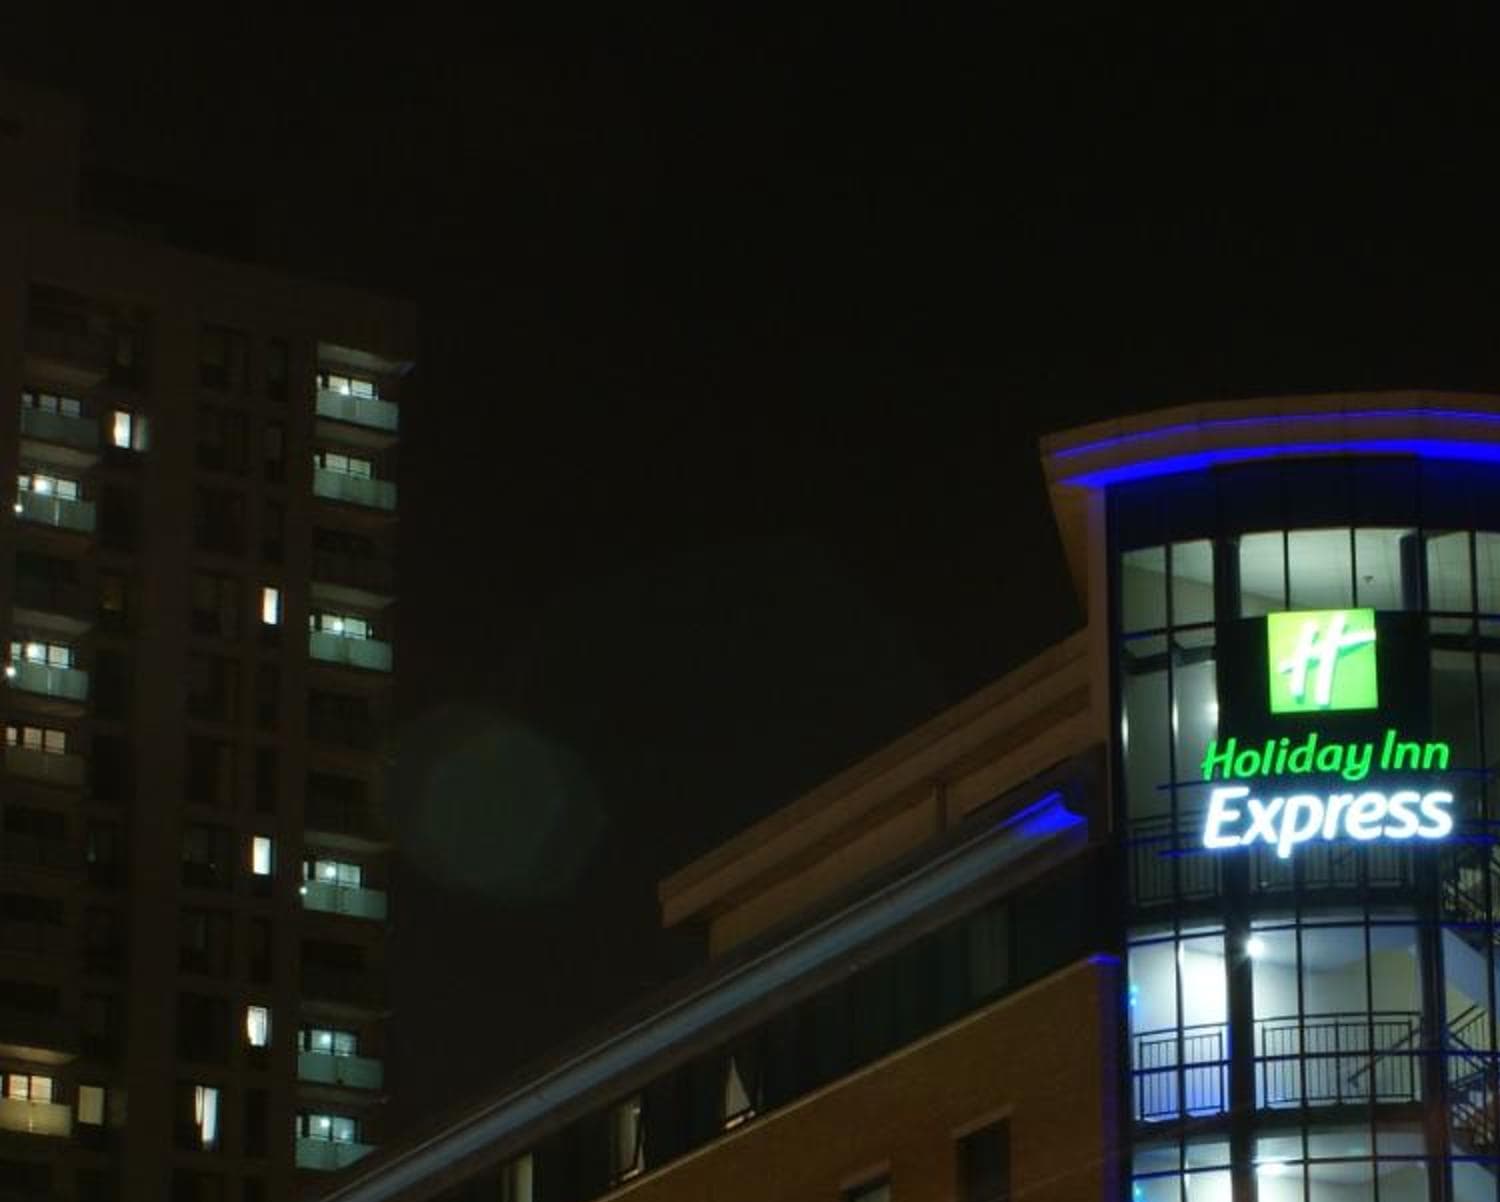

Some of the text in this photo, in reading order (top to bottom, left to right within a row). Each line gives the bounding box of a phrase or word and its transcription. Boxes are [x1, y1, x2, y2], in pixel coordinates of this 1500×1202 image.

[1201, 729, 1450, 781] Holiday Inn
[1202, 786, 1454, 859] Express
